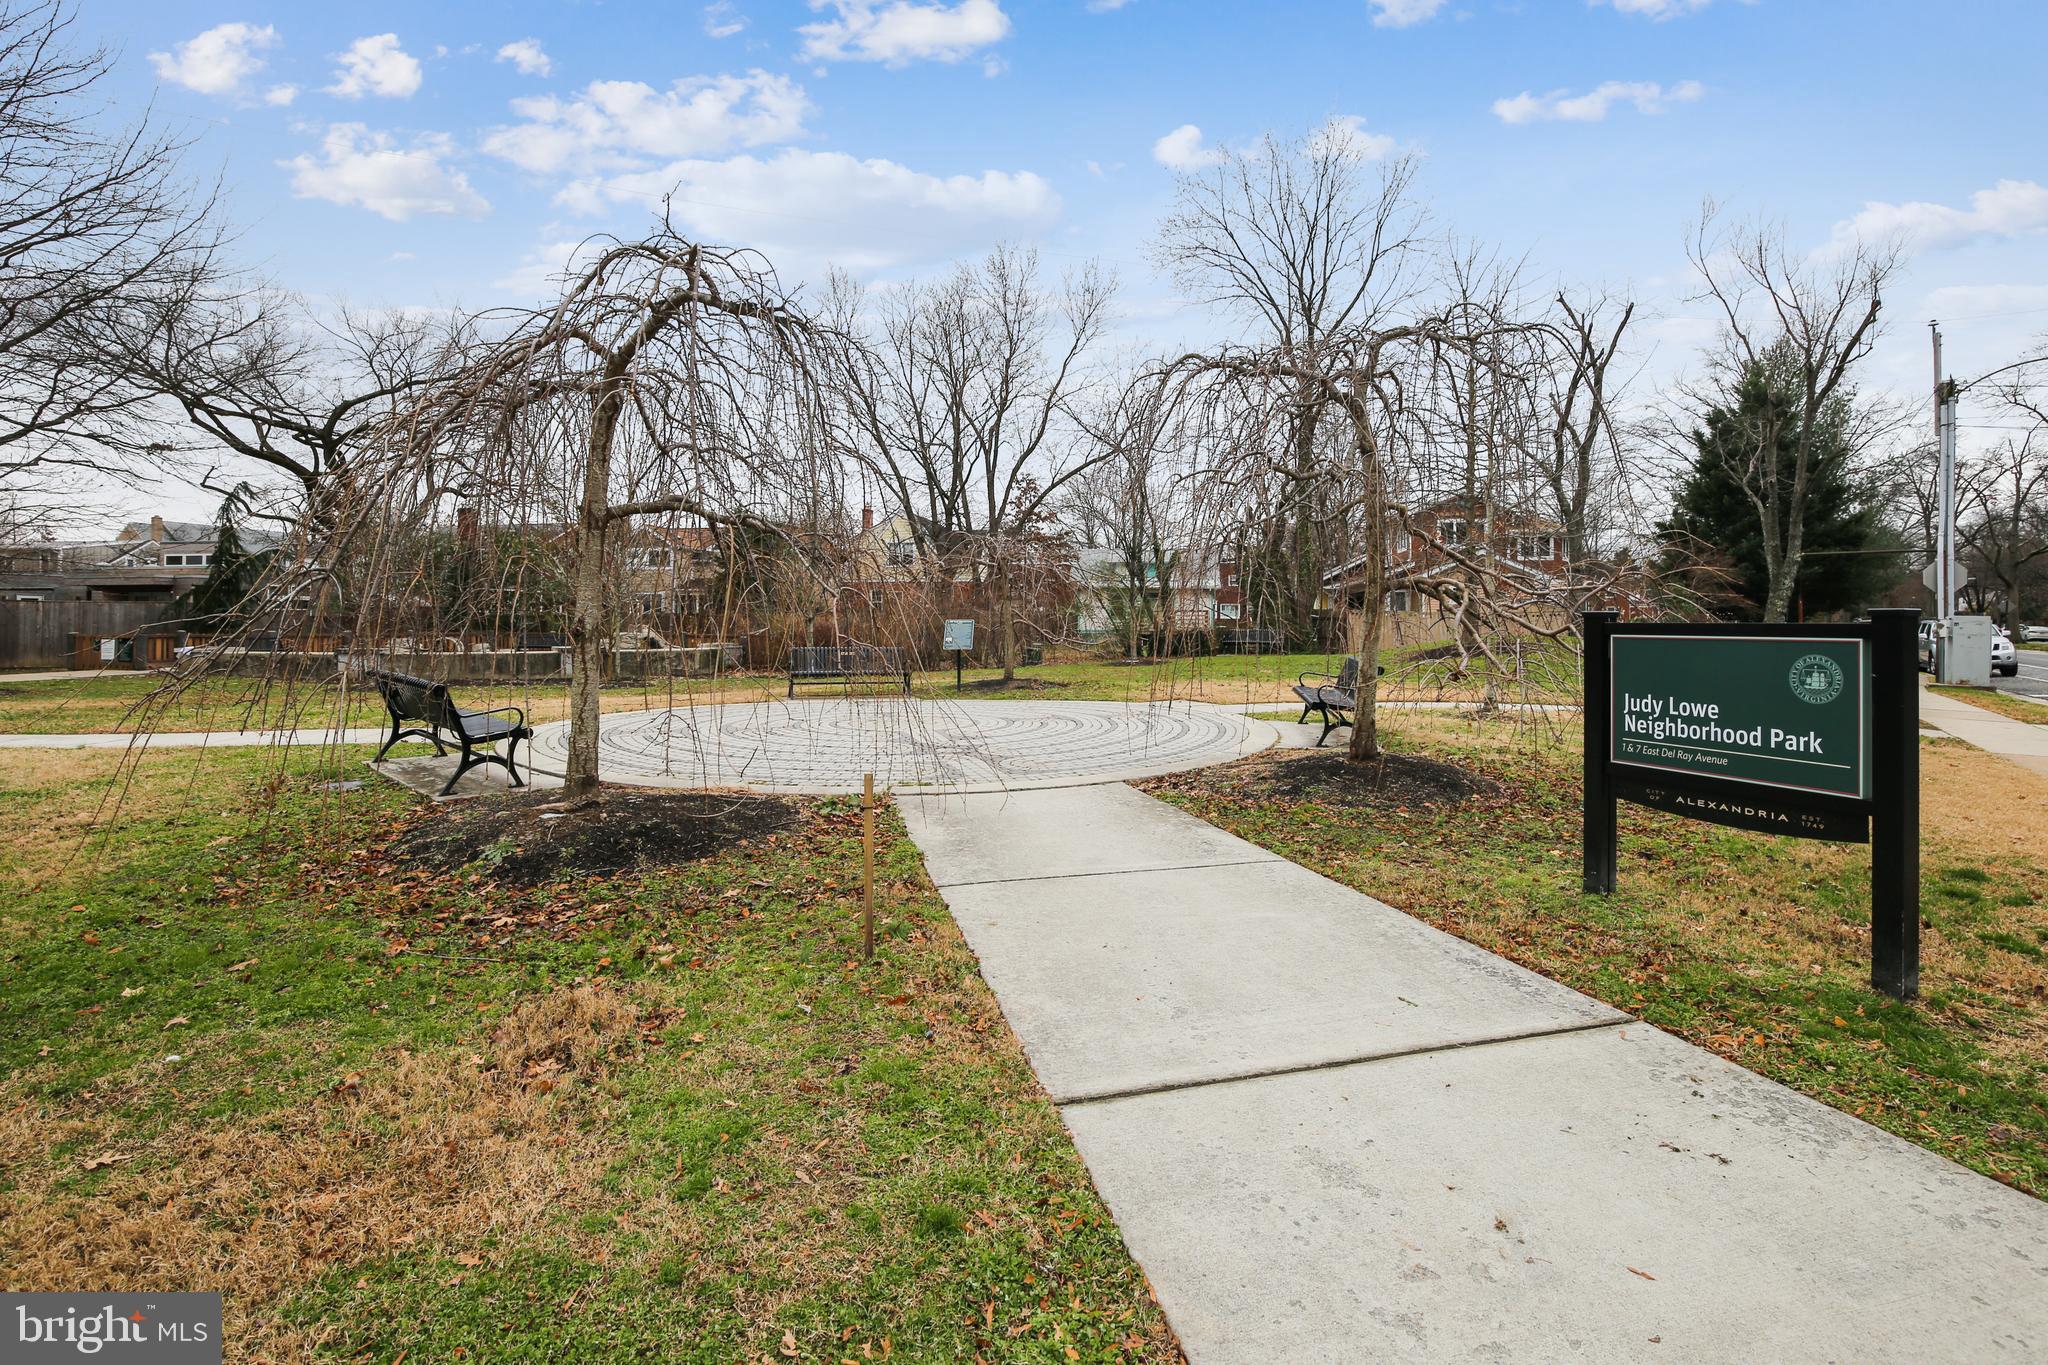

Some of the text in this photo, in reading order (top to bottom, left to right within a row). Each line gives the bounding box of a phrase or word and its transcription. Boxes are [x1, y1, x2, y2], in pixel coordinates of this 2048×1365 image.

[1623, 693, 1719, 719] Judy Lowe
[1624, 714, 1823, 754] Neighborhood Park
[1622, 743, 1729, 766] 1 & 7 East Del Ray Avenue
[1676, 796, 1789, 823] ALEXANDRIA
[1801, 821, 1825, 830] 1749
